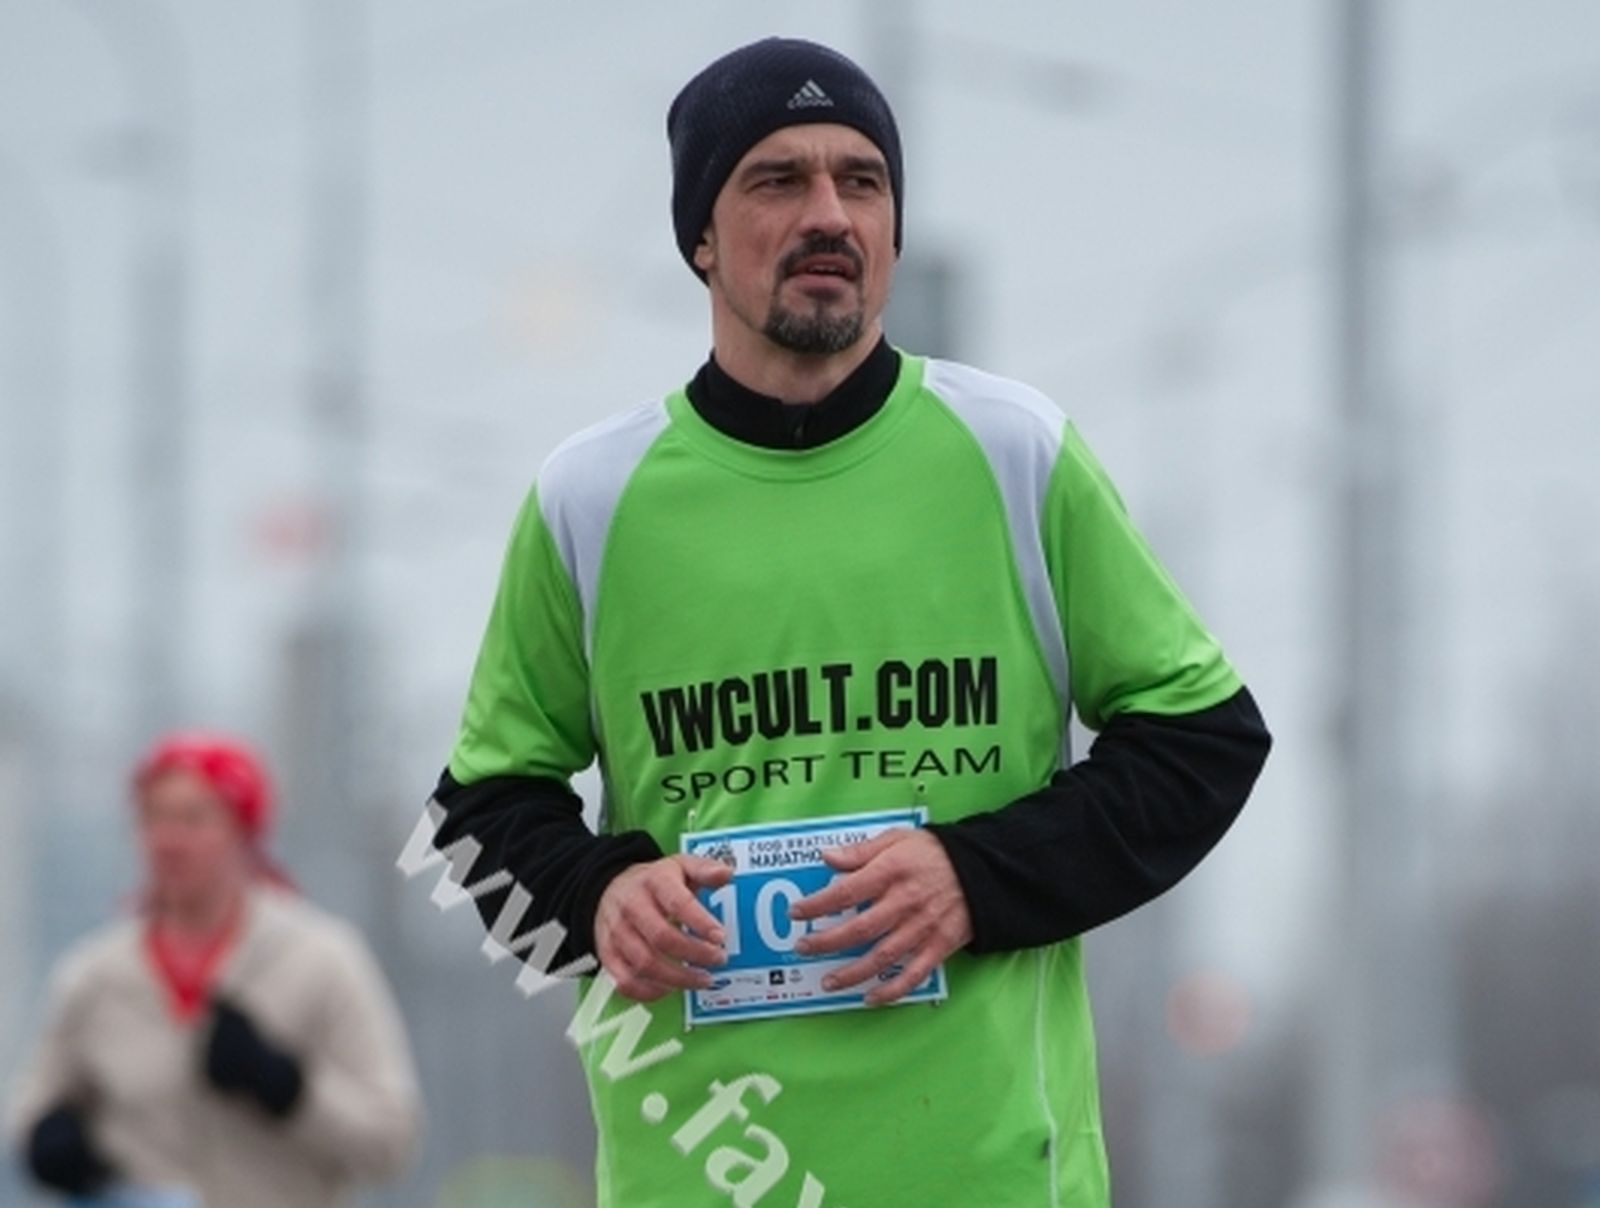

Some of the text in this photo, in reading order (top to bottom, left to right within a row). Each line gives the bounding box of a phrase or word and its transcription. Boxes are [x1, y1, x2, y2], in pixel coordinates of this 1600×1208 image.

[640, 656, 998, 758] VWCULT.COM
[660, 745, 1002, 804] SPORT TEAM
[749, 848, 823, 869] MARATHO
[709, 877, 858, 956] 10
